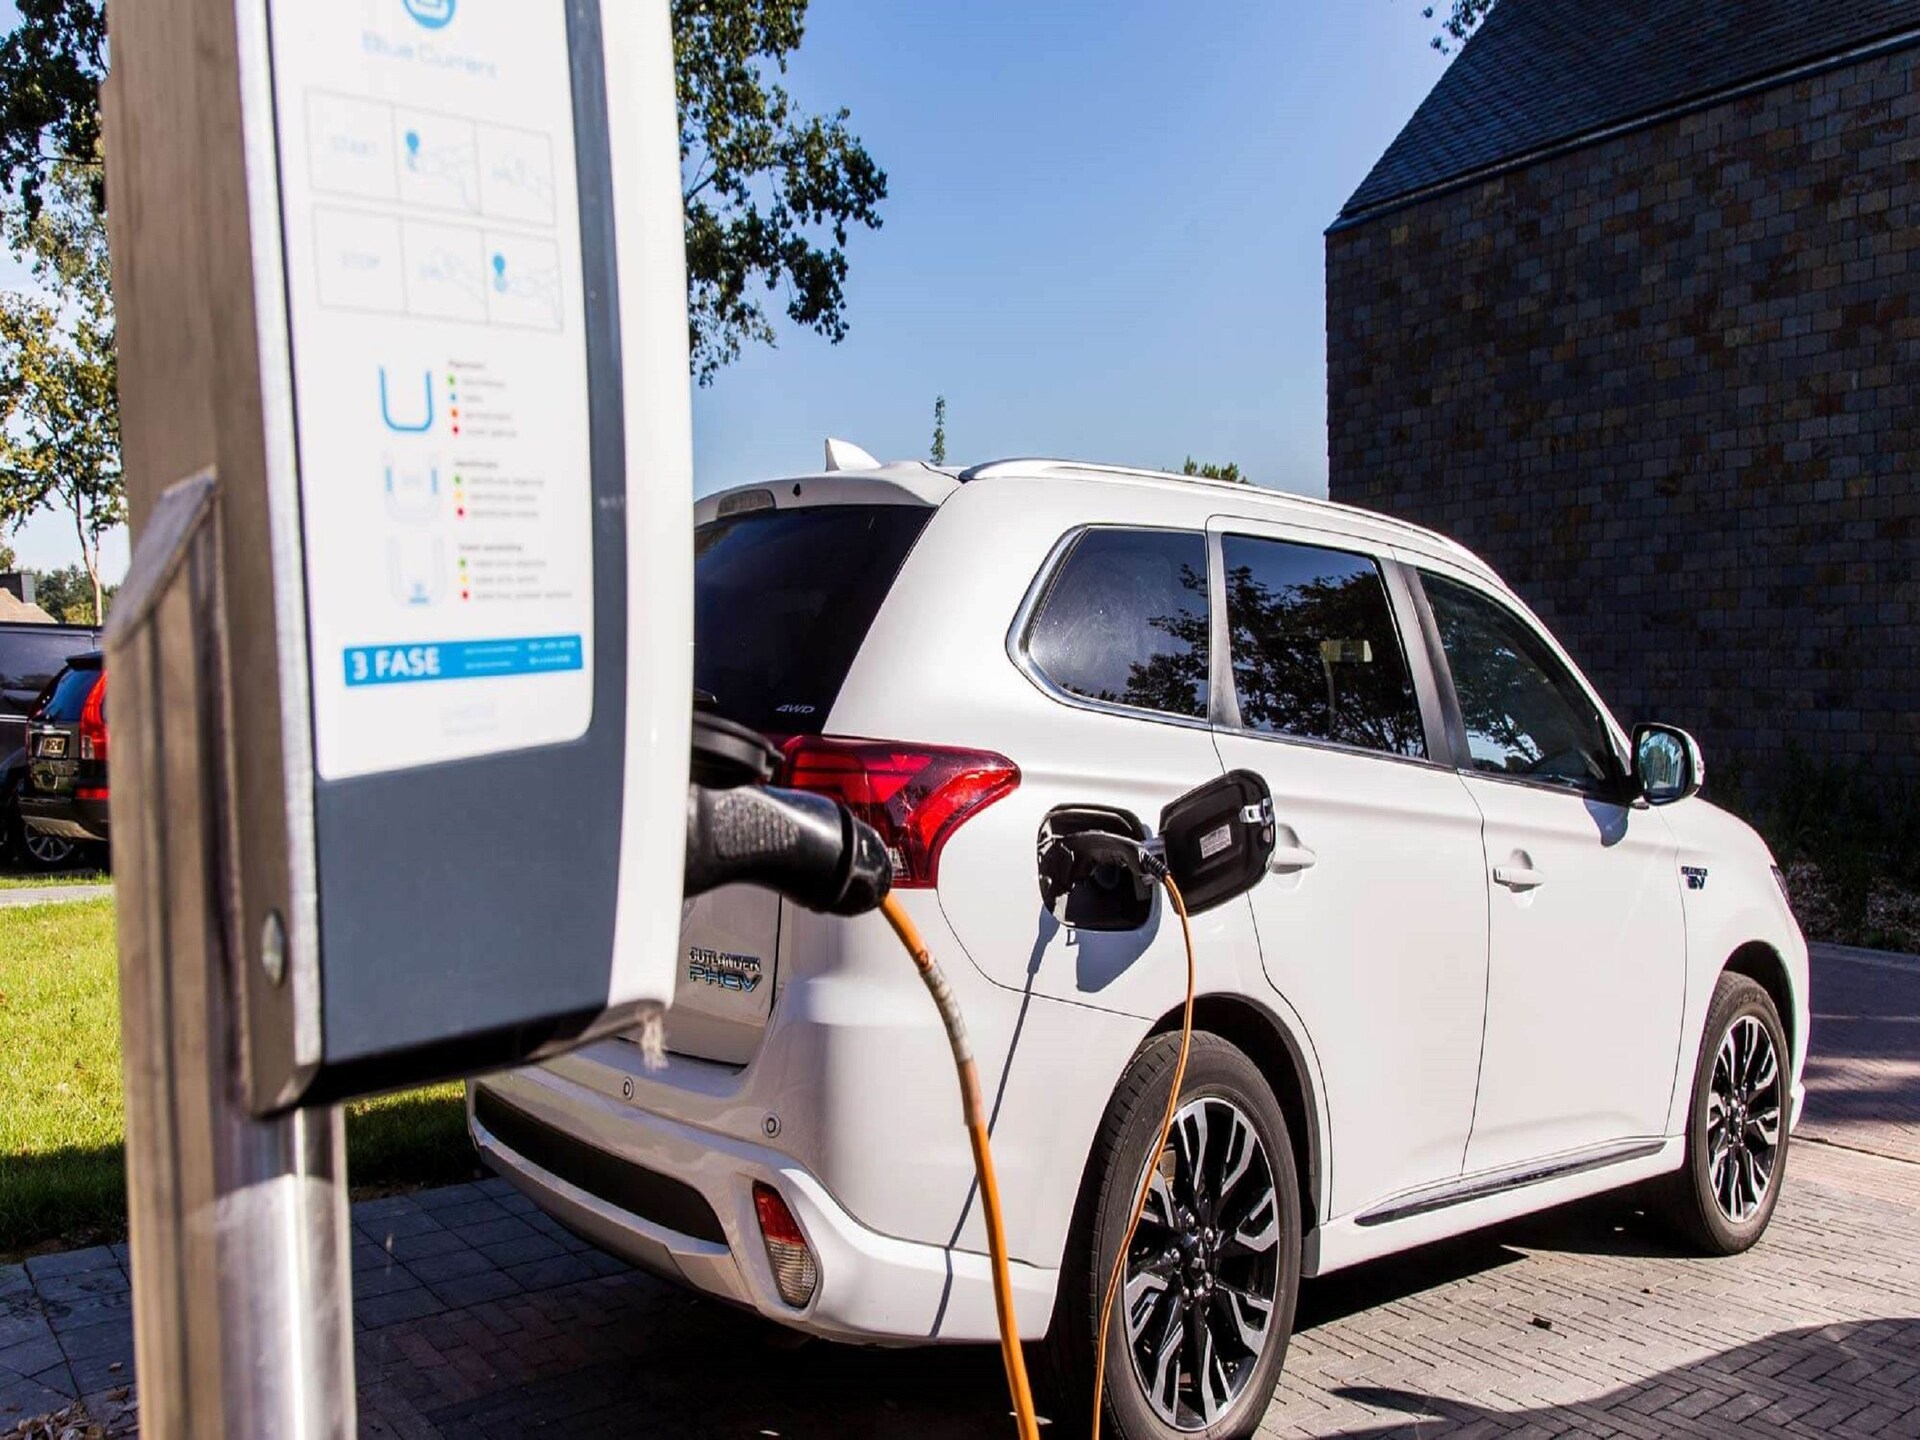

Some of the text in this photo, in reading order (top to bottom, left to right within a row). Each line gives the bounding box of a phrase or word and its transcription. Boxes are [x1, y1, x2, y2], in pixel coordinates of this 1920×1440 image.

[352, 646, 441, 680] 3 FASE
[776, 704, 815, 713] 4WD
[689, 947, 761, 972] OUTLANDER
[689, 964, 763, 992] PHEV
